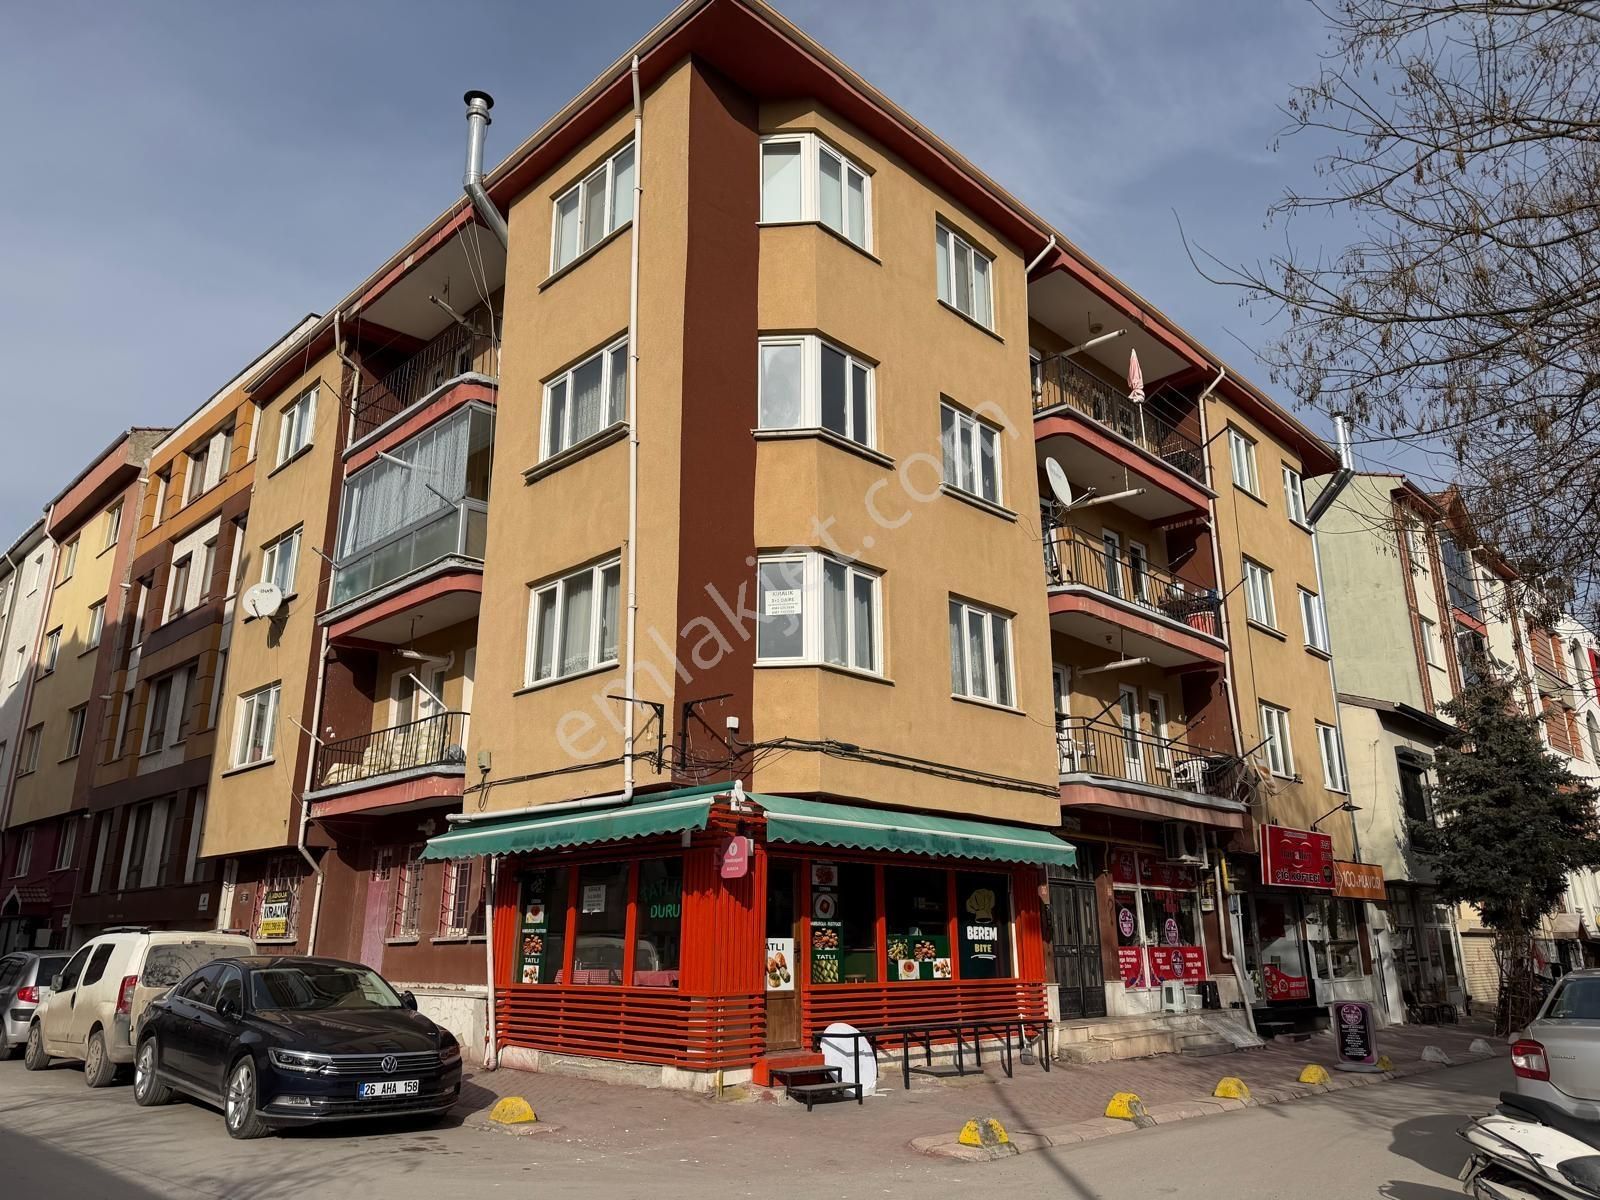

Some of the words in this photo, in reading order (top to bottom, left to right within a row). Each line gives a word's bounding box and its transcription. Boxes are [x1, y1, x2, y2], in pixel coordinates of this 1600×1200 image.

[650, 903, 681, 918] DURU
[966, 925, 998, 941] BEREM
[974, 943, 992, 953] BITE
[365, 1084, 376, 1096] 26
[381, 1082, 397, 1095] AHA
[404, 1081, 418, 1093] 158
